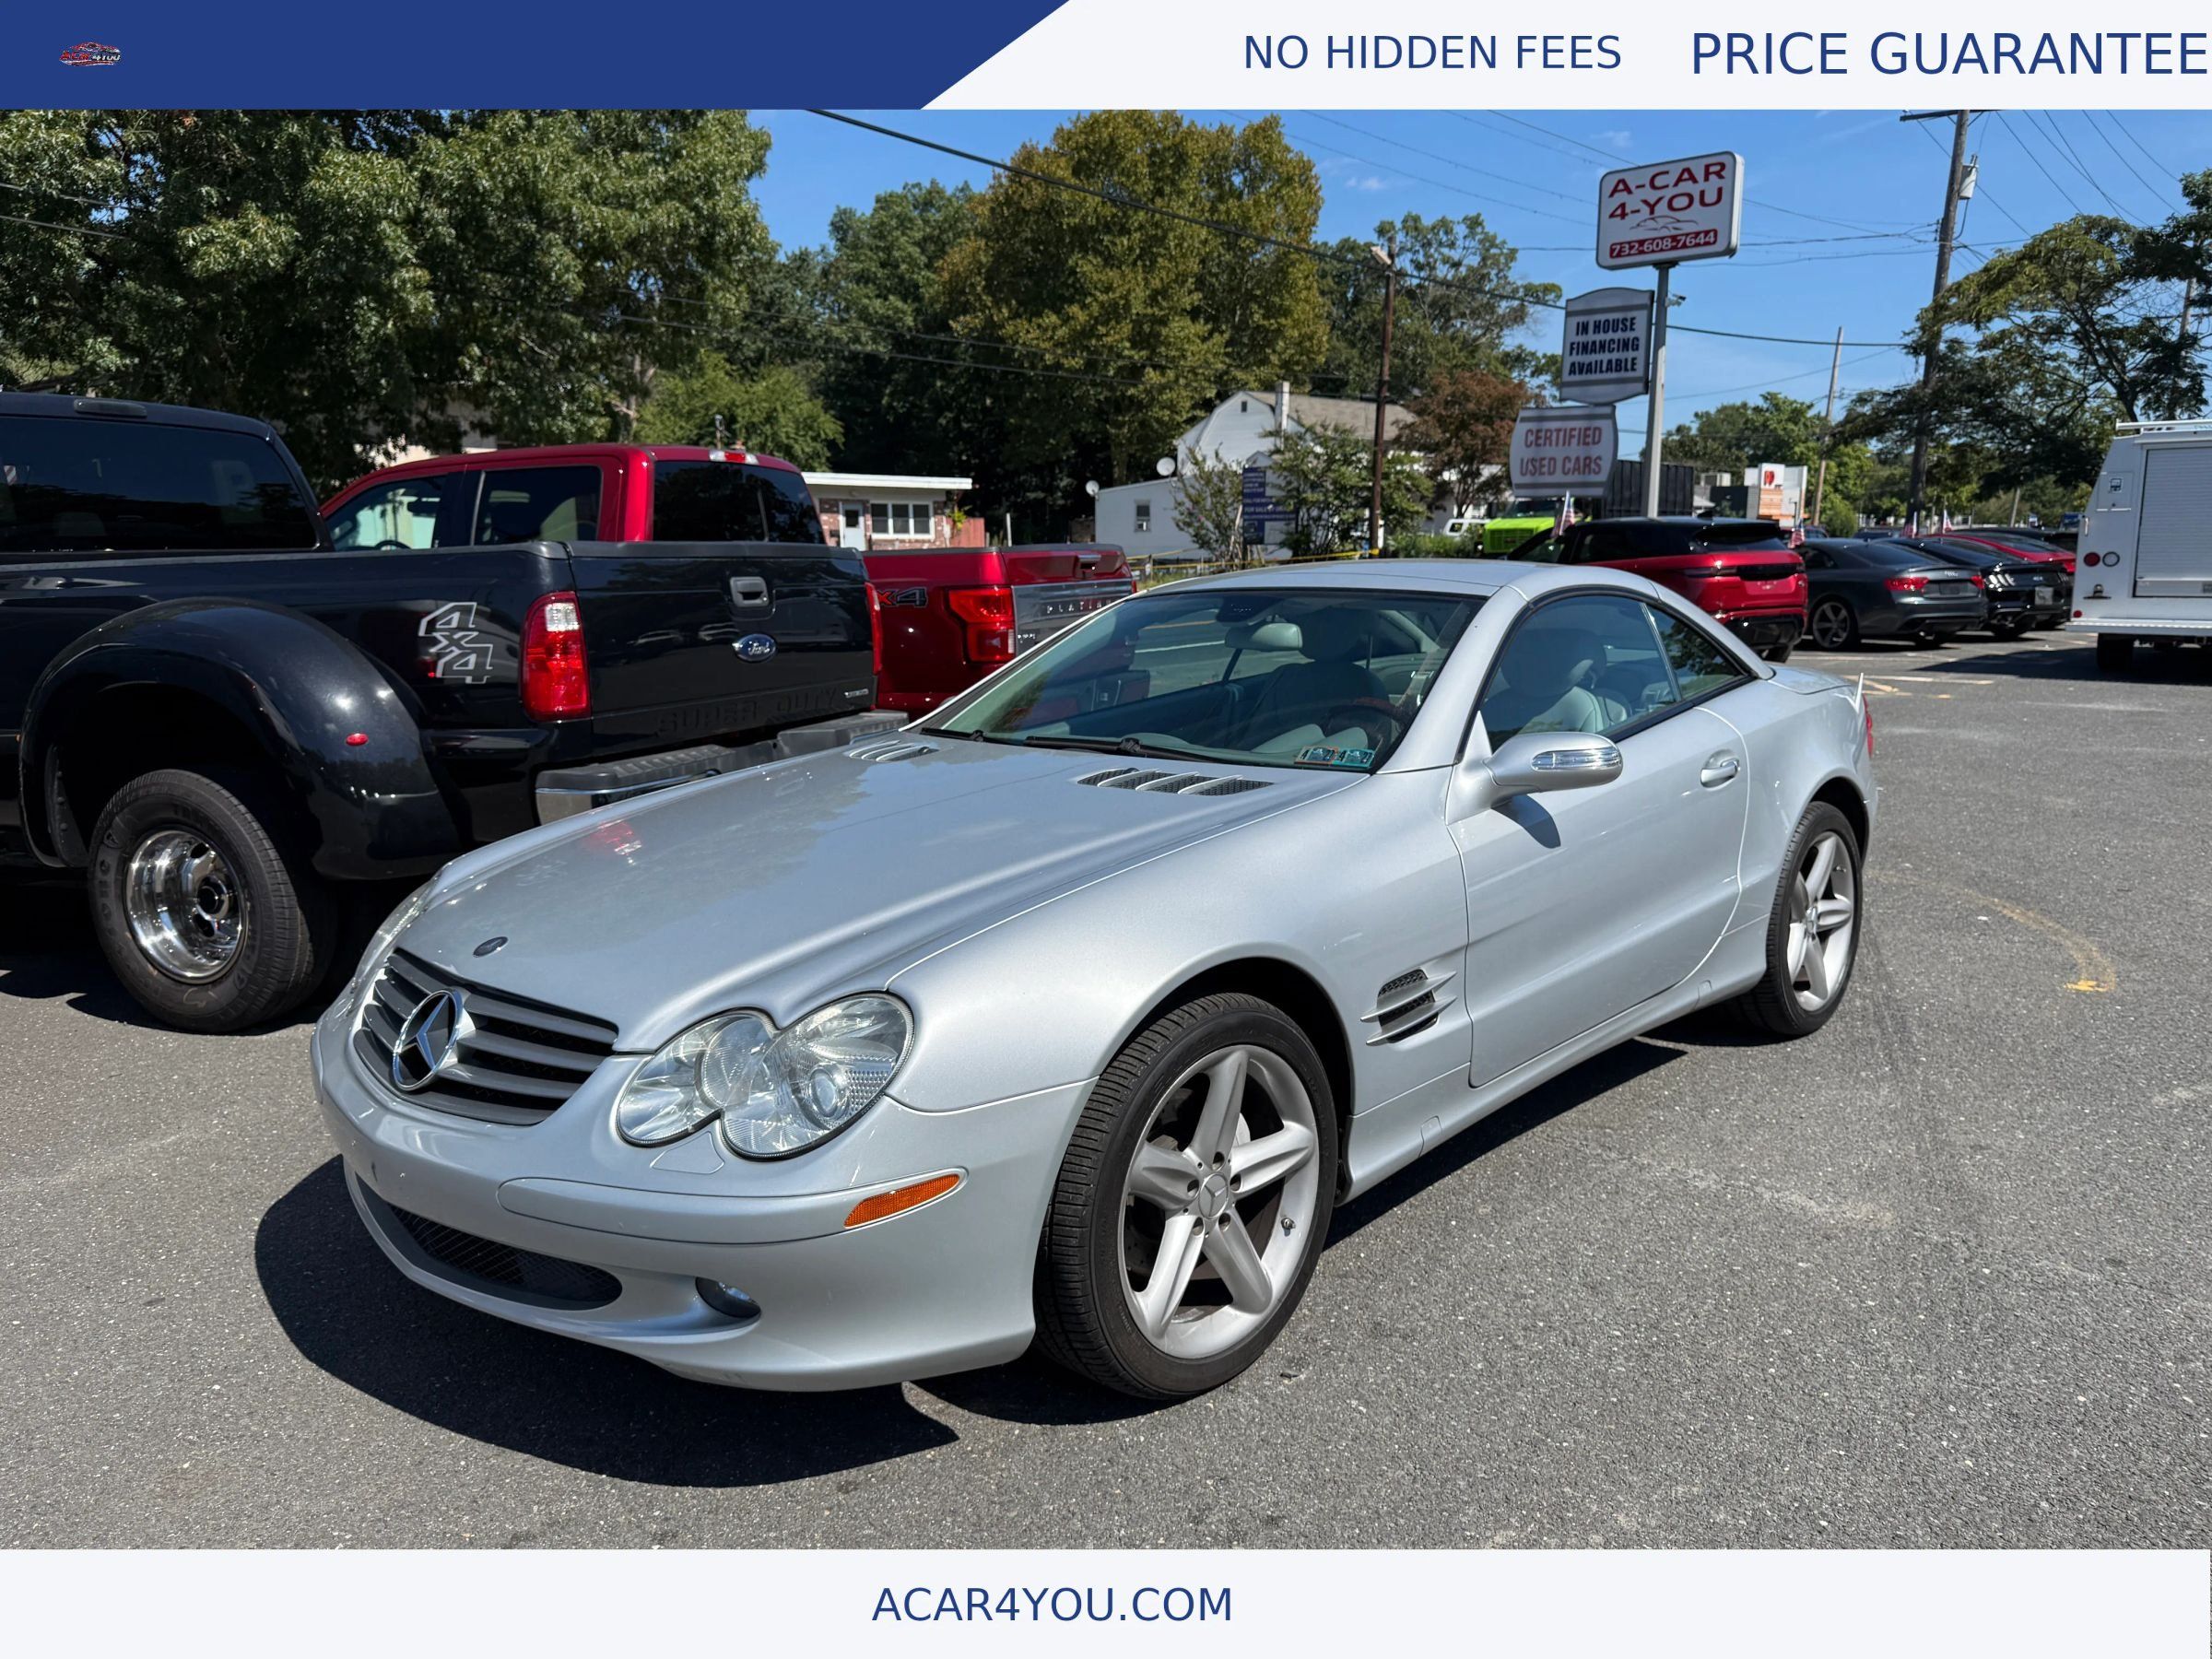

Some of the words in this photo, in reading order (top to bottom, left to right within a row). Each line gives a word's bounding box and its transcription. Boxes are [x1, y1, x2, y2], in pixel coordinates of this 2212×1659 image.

[1607, 161, 1726, 198] A-CAR
[1608, 186, 1724, 220] 4-YOU
[1611, 231, 1716, 257] 732-608-7644
[1575, 320, 1589, 336] IN
[1593, 316, 1637, 335] HOUSE
[1569, 336, 1640, 357] FINANCING
[1568, 357, 1638, 376] AVAILABLE
[1524, 426, 1603, 449] CERTIFIED
[1520, 457, 1557, 477] USED
[1561, 455, 1603, 476] CARS
[747, 641, 771, 656] Ford
